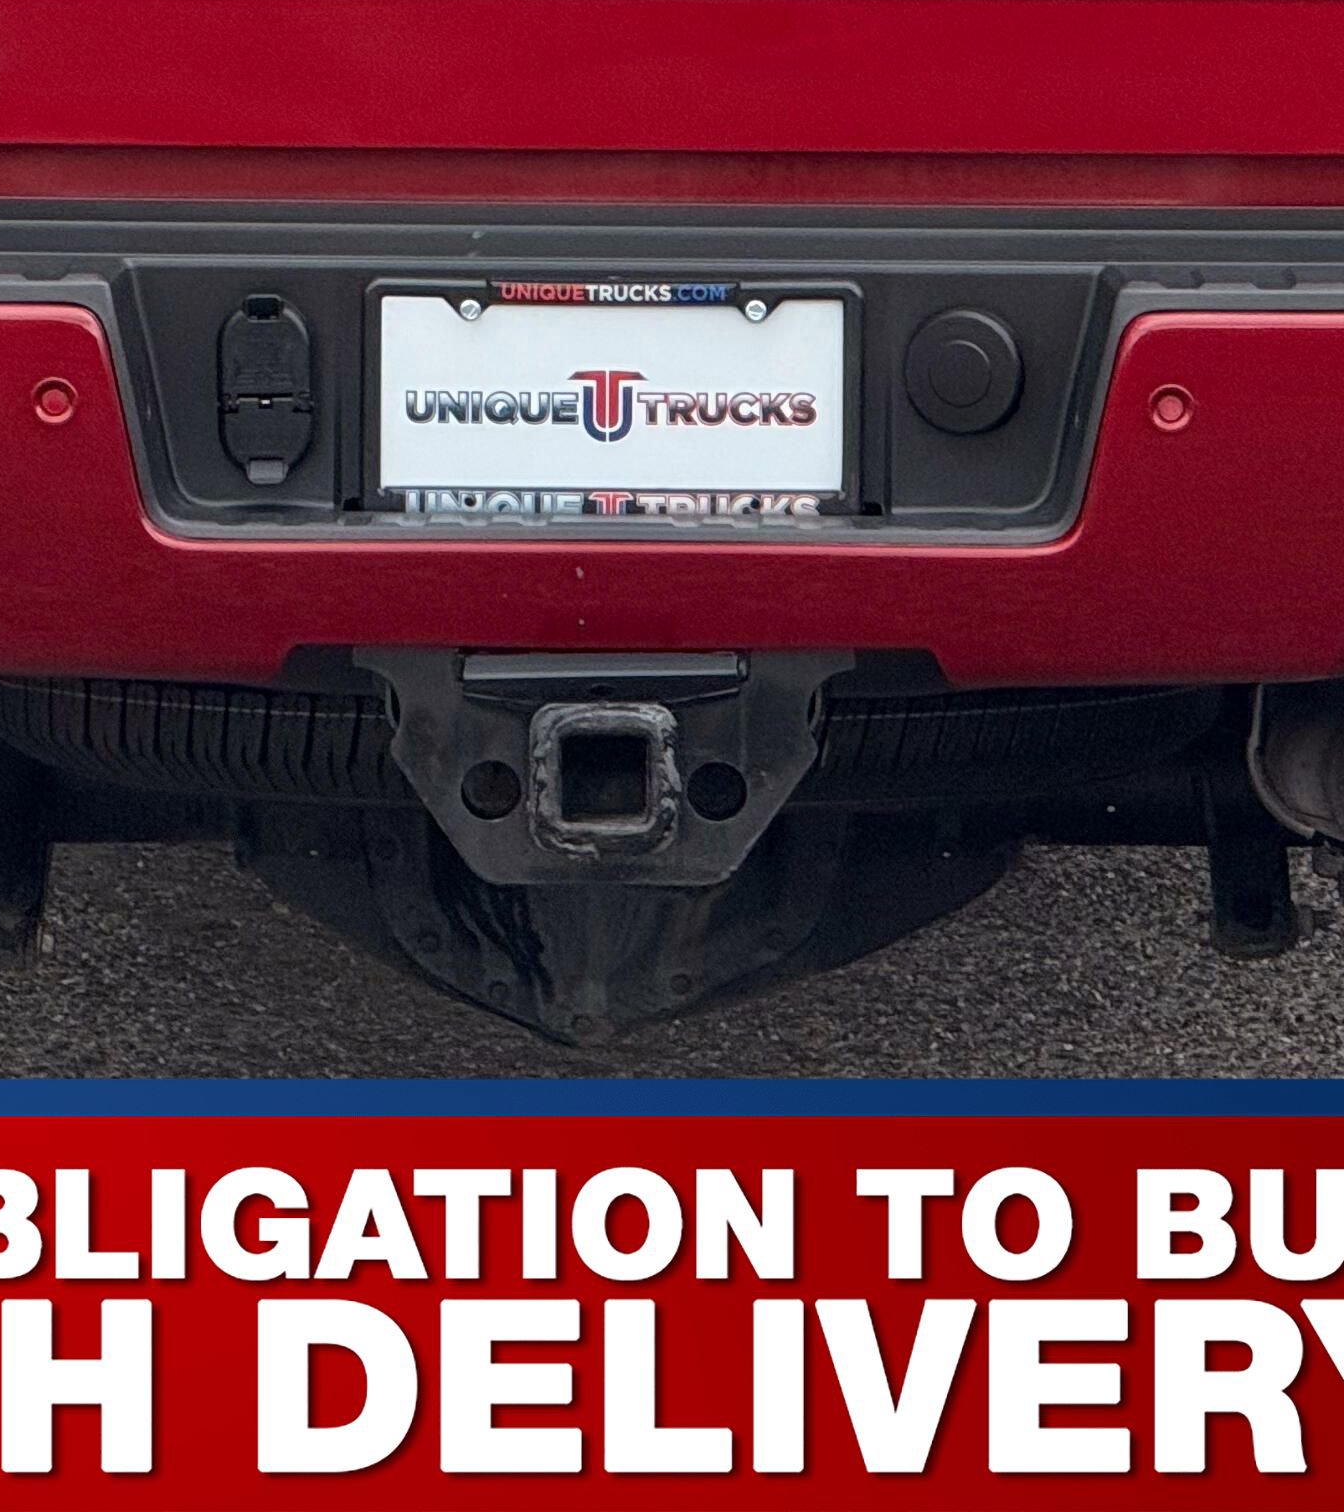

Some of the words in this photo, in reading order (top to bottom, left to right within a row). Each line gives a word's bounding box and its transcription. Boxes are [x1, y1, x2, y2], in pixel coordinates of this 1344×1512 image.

[500, 284, 727, 303] UNIQUETRUCKS.COM
[405, 390, 579, 426] UNIQUE
[638, 392, 817, 426] TRUCKS
